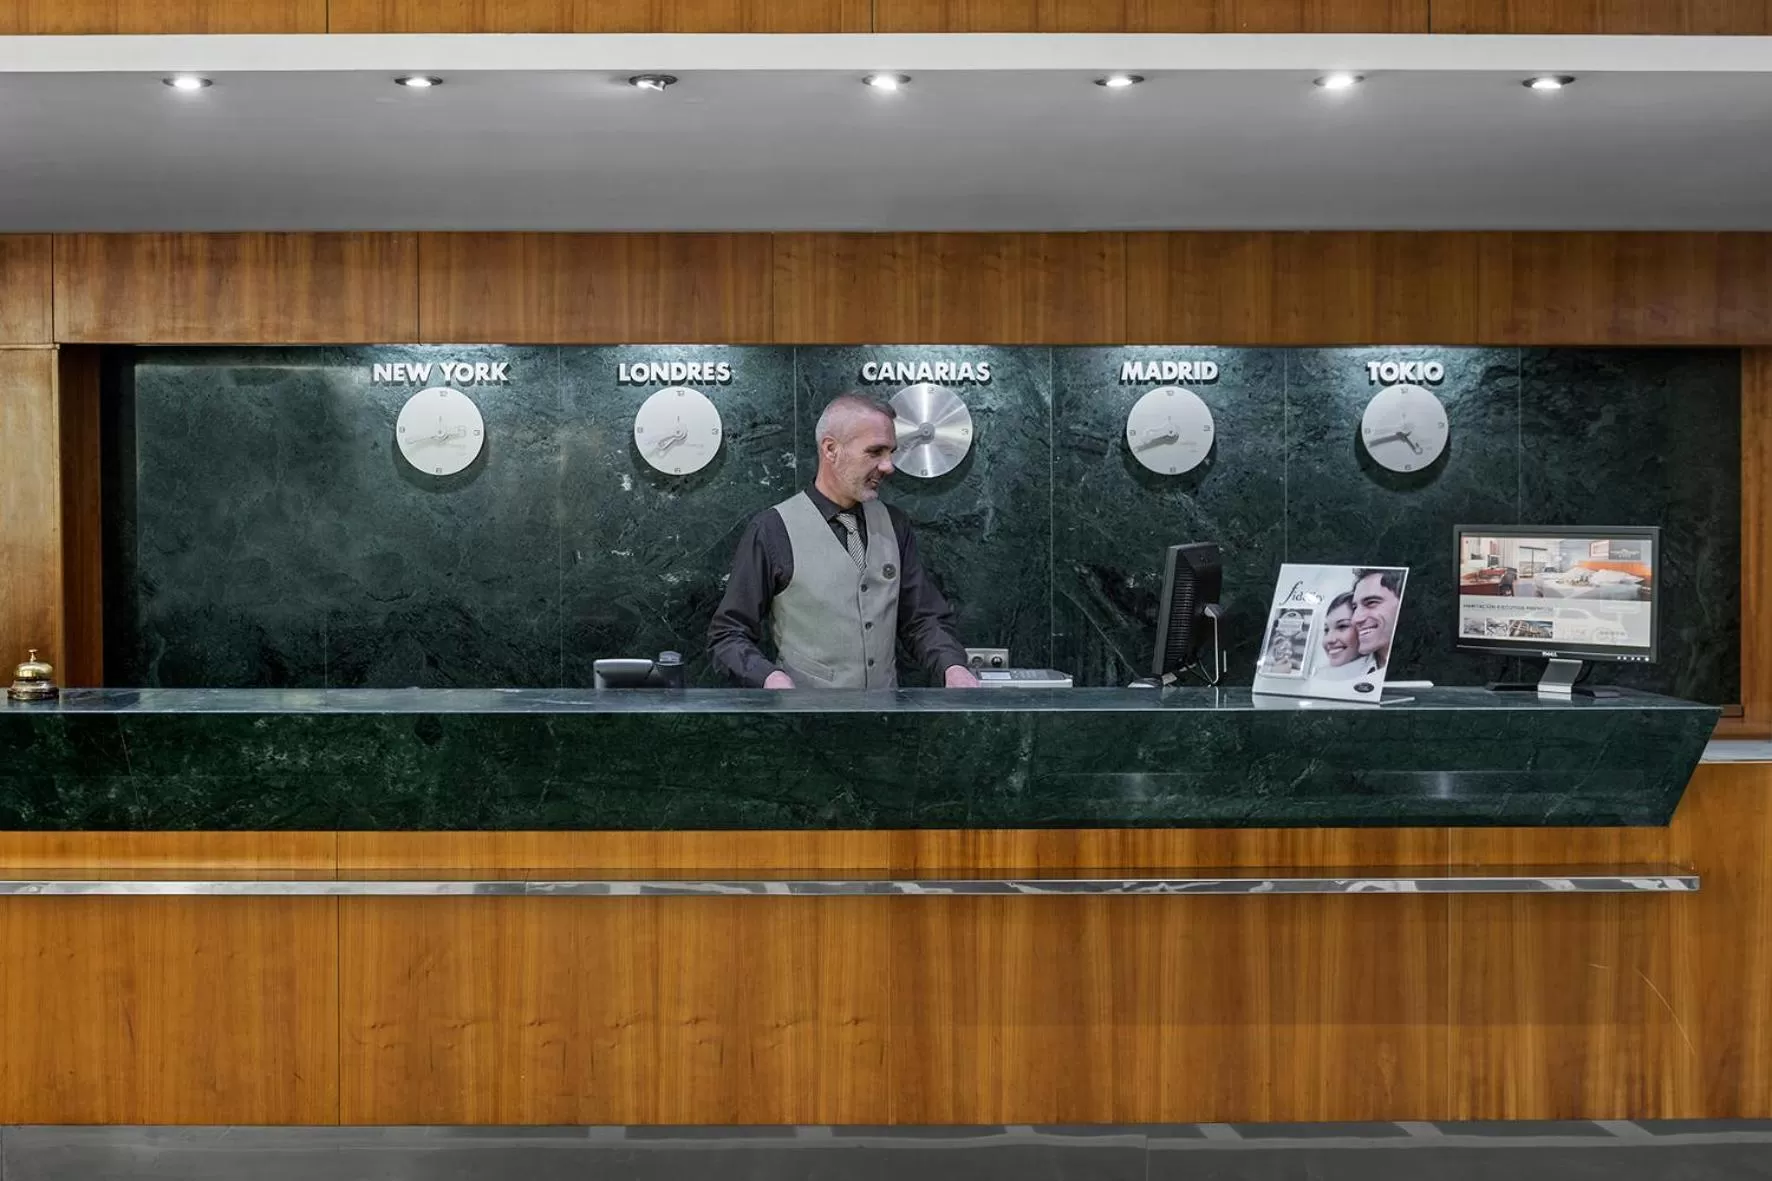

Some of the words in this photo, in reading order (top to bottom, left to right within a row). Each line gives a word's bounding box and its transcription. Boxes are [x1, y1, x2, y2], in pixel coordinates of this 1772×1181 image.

[373, 362, 433, 382] NEW
[439, 362, 509, 382] YORK
[619, 361, 732, 382] LONDRES
[862, 361, 991, 381] CANARIAS
[1121, 361, 1218, 381] MADRID
[1367, 361, 1444, 382] TOKIO
